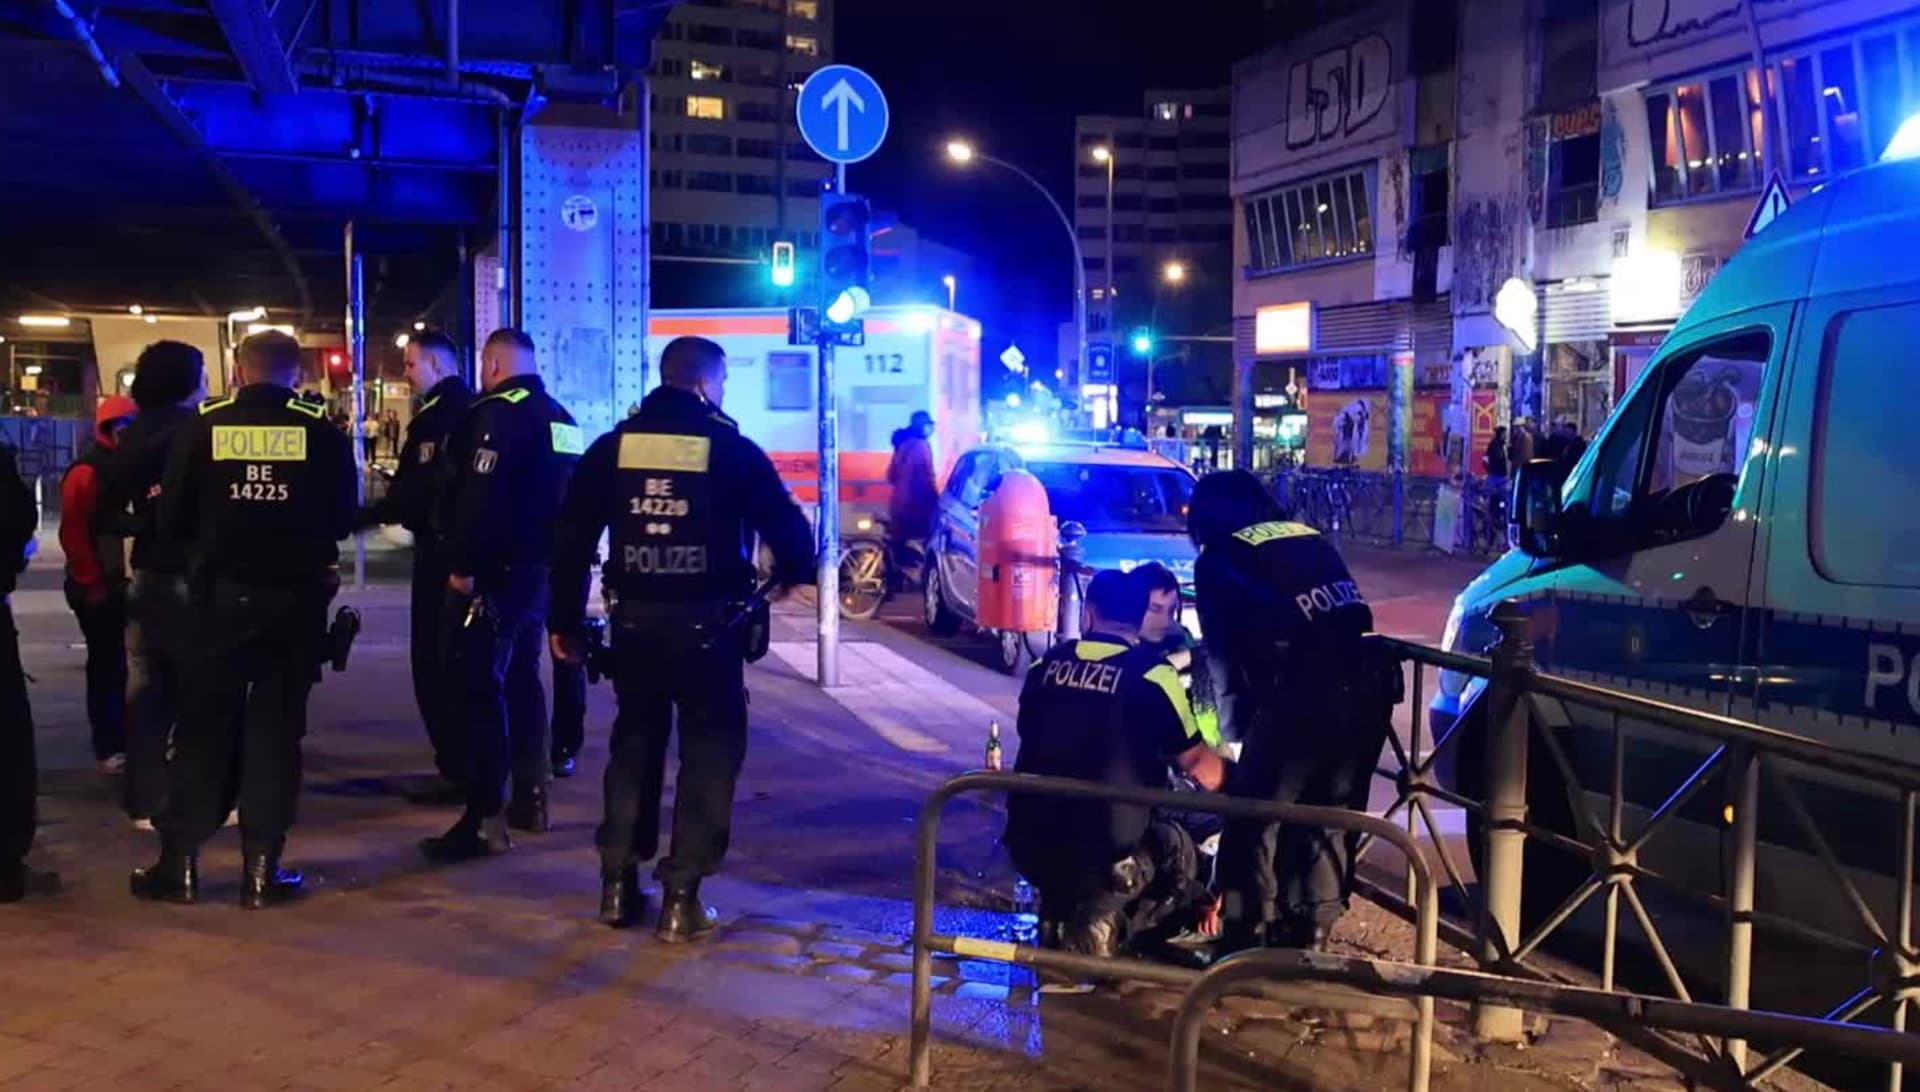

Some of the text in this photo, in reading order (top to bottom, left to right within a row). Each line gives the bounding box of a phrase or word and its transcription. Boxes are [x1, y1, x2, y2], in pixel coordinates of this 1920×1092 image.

[865, 354, 903, 374] 112
[215, 430, 304, 457] POLIZEI
[246, 465, 273, 481] BE
[229, 483, 289, 501] 14225
[645, 478, 673, 496] BE
[624, 545, 707, 573] POLIZEI
[1043, 660, 1123, 695] POLIZEI
